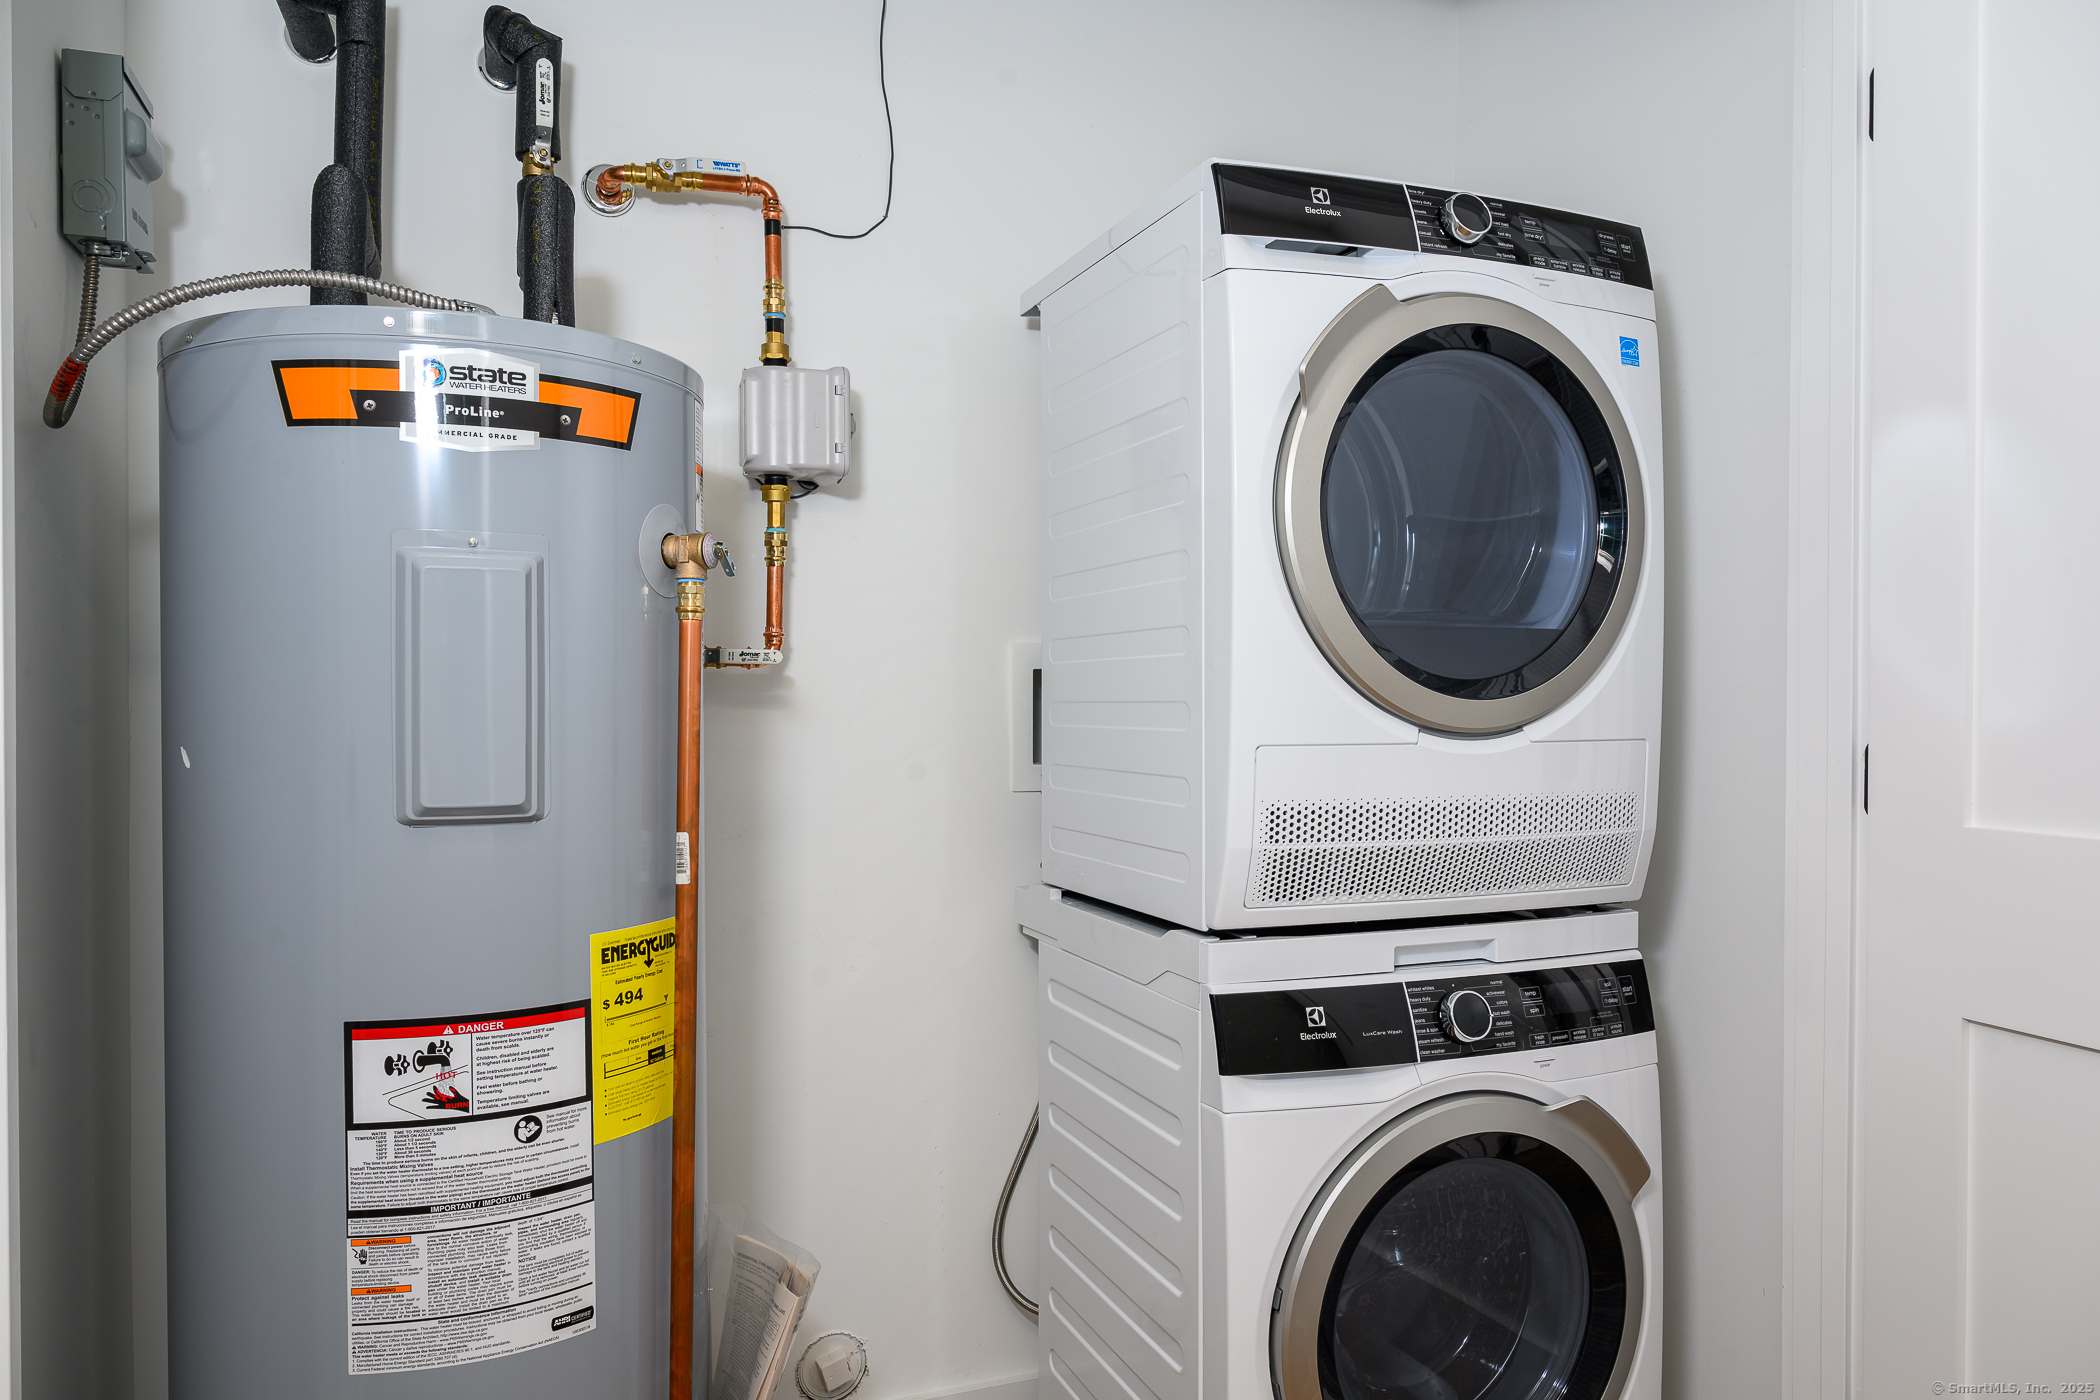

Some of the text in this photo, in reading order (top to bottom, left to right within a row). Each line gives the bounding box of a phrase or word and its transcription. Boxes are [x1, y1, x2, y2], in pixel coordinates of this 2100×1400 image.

[1305, 207, 1341, 216] Electrolux
[449, 365, 526, 386] state
[450, 382, 527, 394] WATER HEATERS
[601, 932, 675, 964] ENERGYGUID
[603, 987, 643, 1010] $ 494
[458, 1022, 504, 1033] DANGER
[491, 1032, 520, 1040] temperature
[1300, 1032, 1337, 1040] Electrolux
[436, 1071, 457, 1080] HOT
[495, 1071, 523, 1079] temperature
[430, 1201, 477, 1212] IMPORTANT
[482, 1192, 531, 1206] IMPORTANTE
